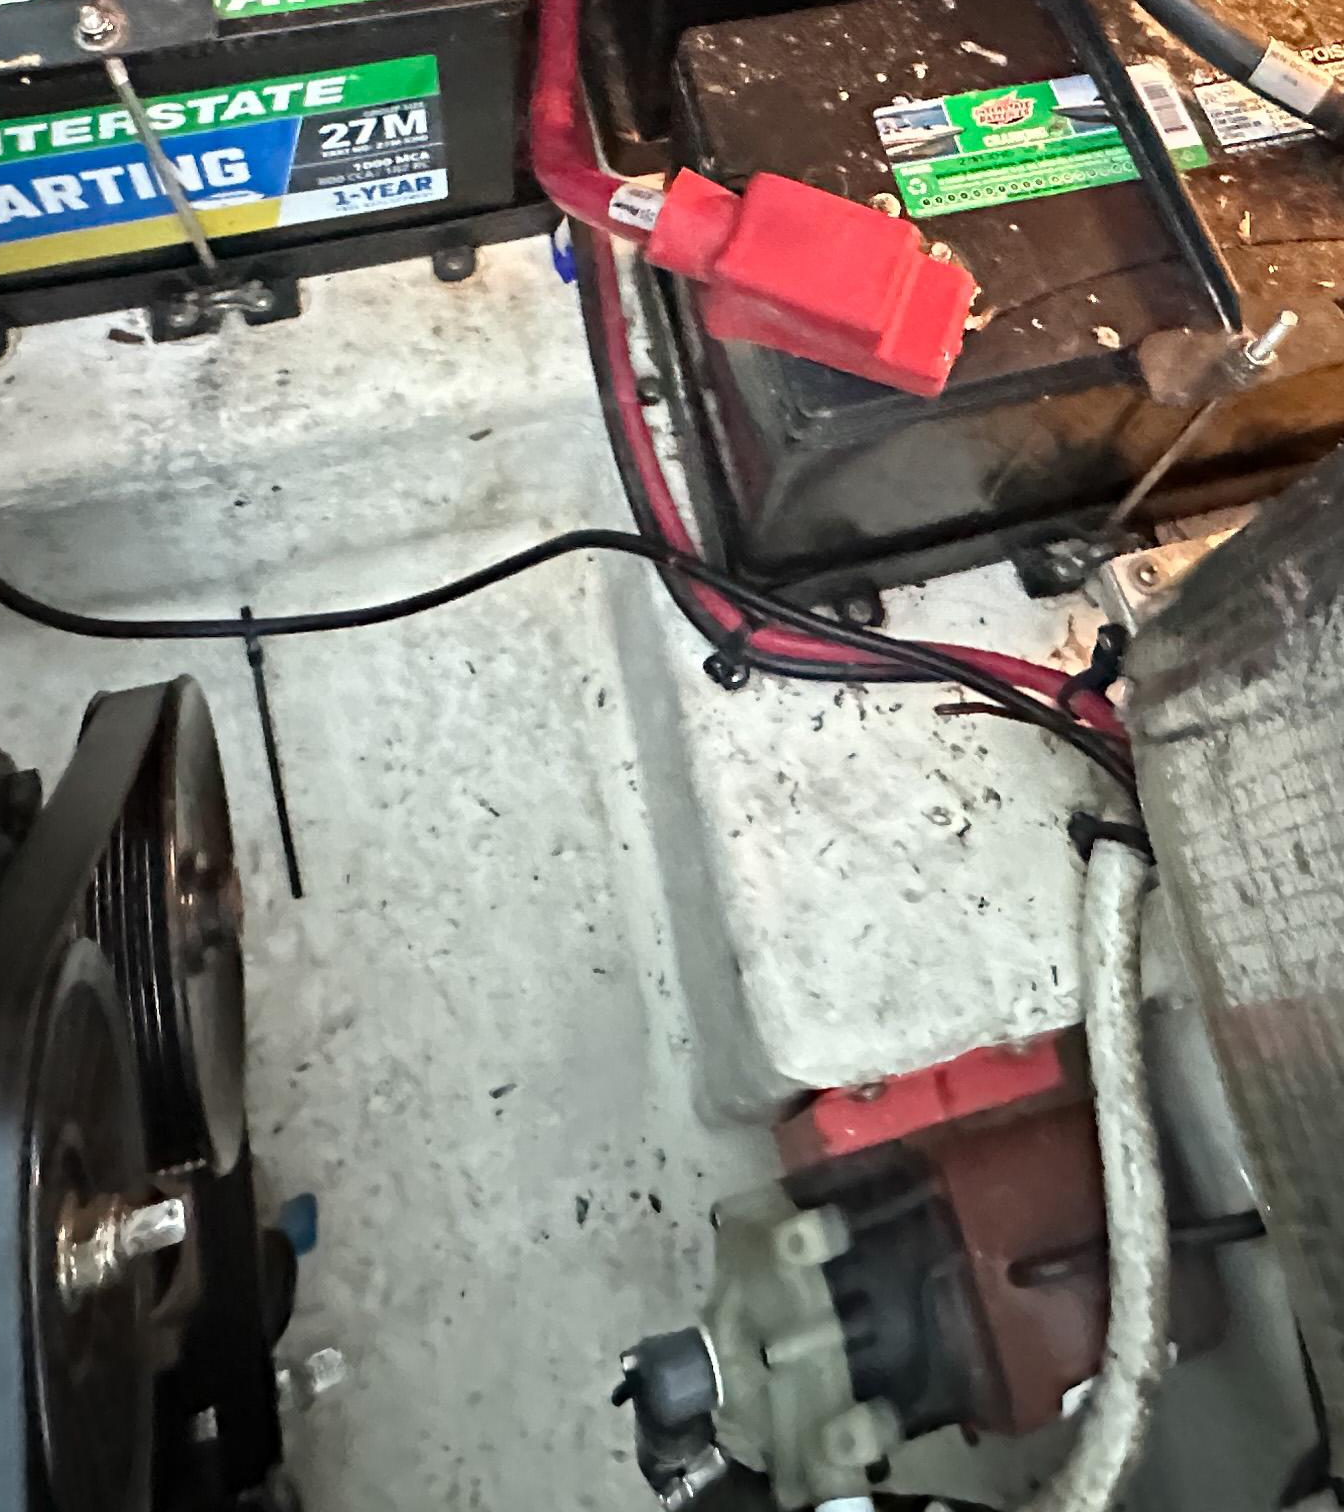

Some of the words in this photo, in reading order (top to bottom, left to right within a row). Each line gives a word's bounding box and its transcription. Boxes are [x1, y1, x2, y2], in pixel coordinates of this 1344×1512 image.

[318, 108, 427, 150] 27M
[395, 151, 431, 164] MCA
[333, 176, 433, 205] 1-YEAR
